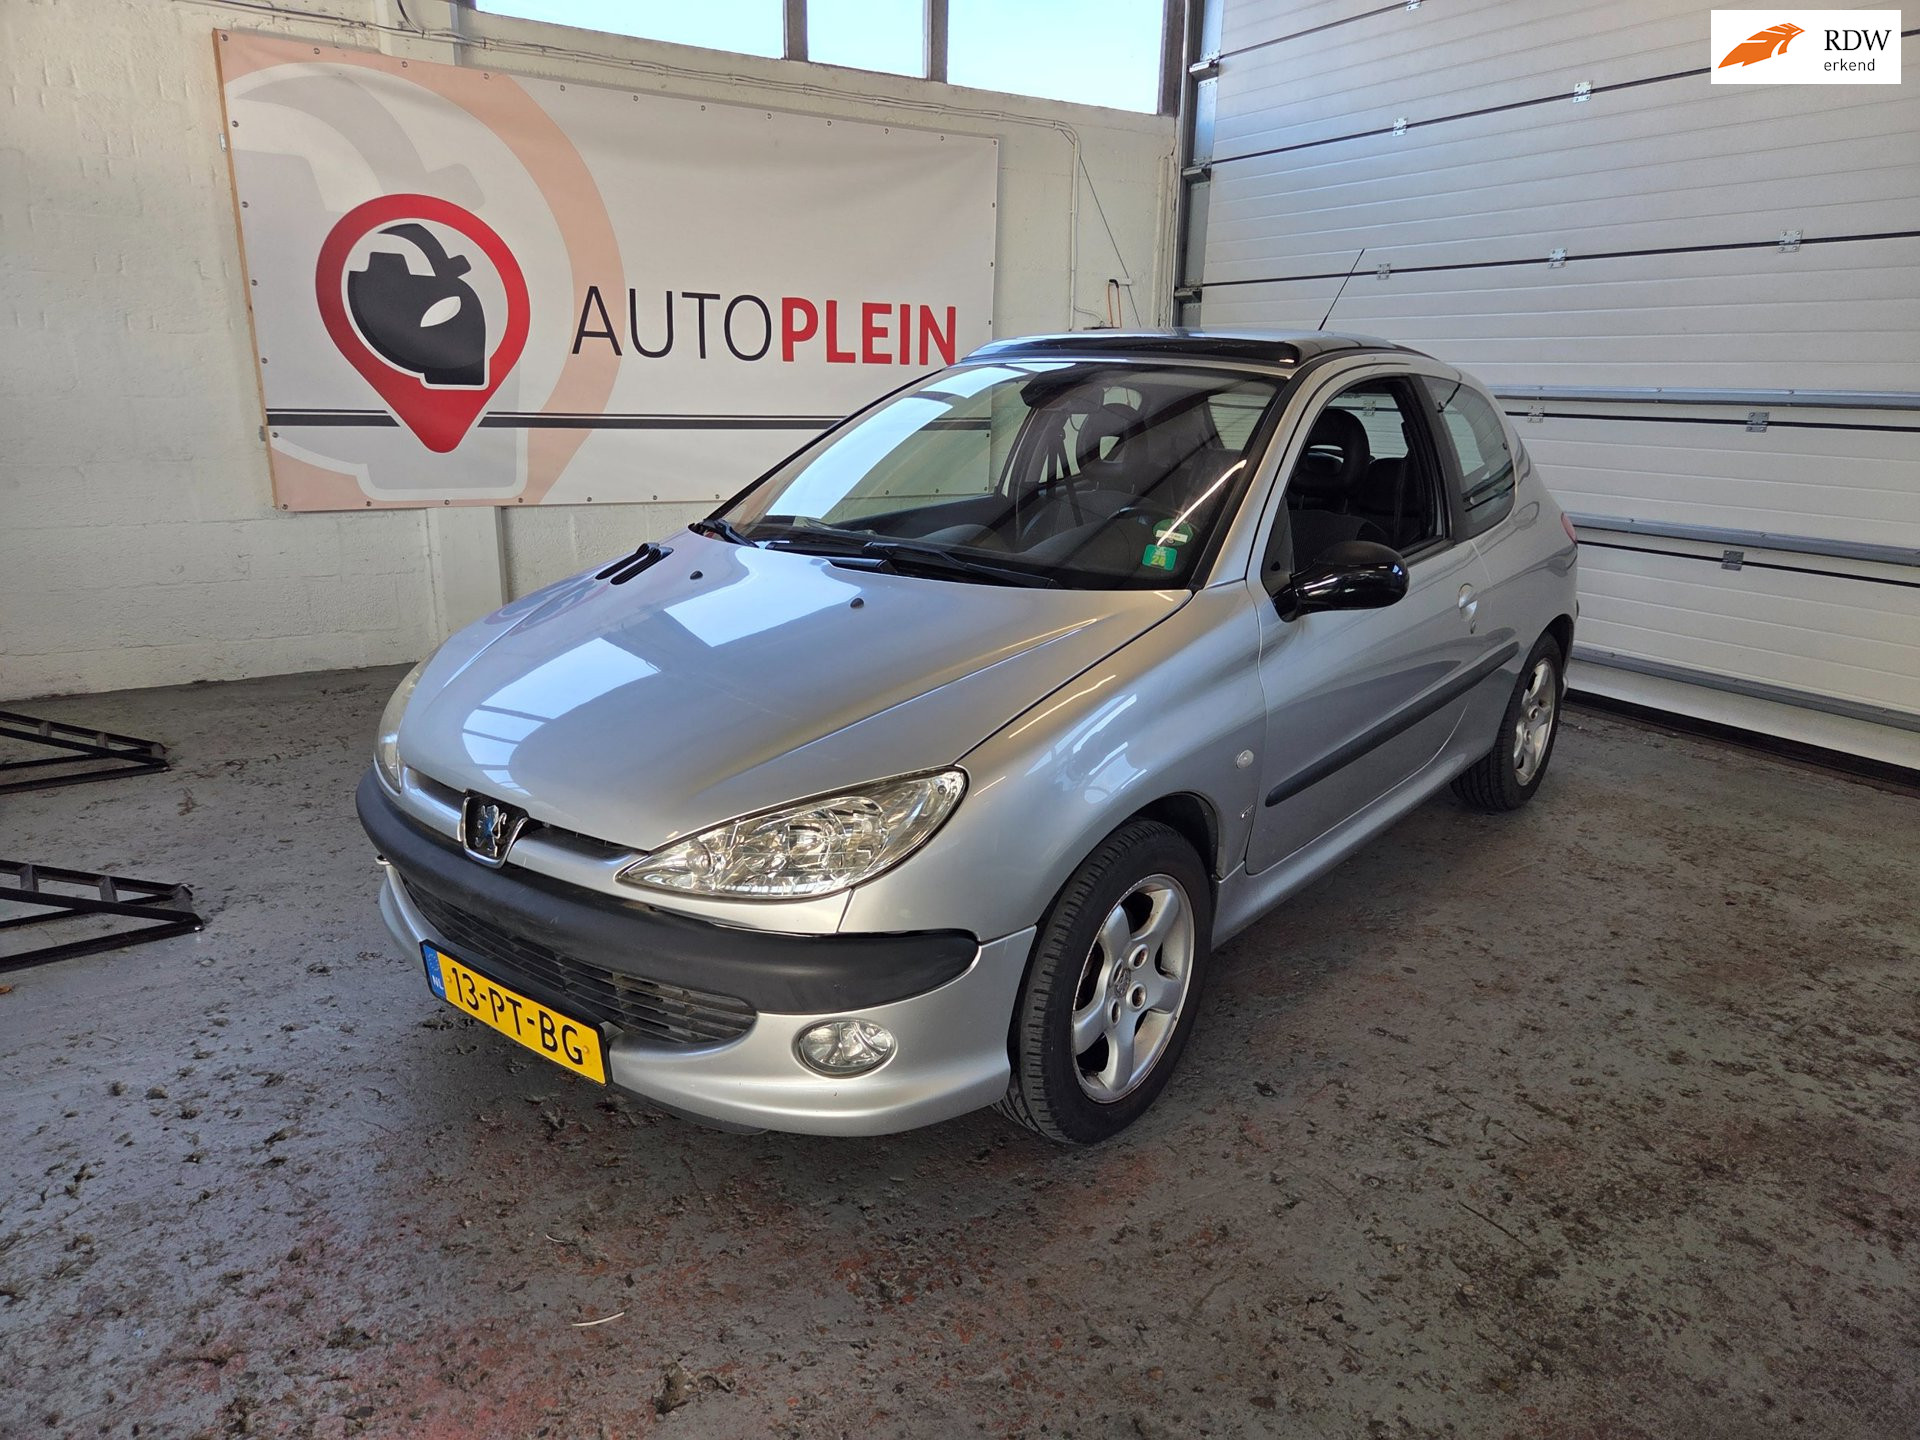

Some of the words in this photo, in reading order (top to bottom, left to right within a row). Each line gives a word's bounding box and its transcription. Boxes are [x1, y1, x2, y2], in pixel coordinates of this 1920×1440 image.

[572, 286, 956, 366] AUTOPLEIN
[432, 975, 444, 990] NL
[452, 967, 583, 1065] 13-PT-BG
